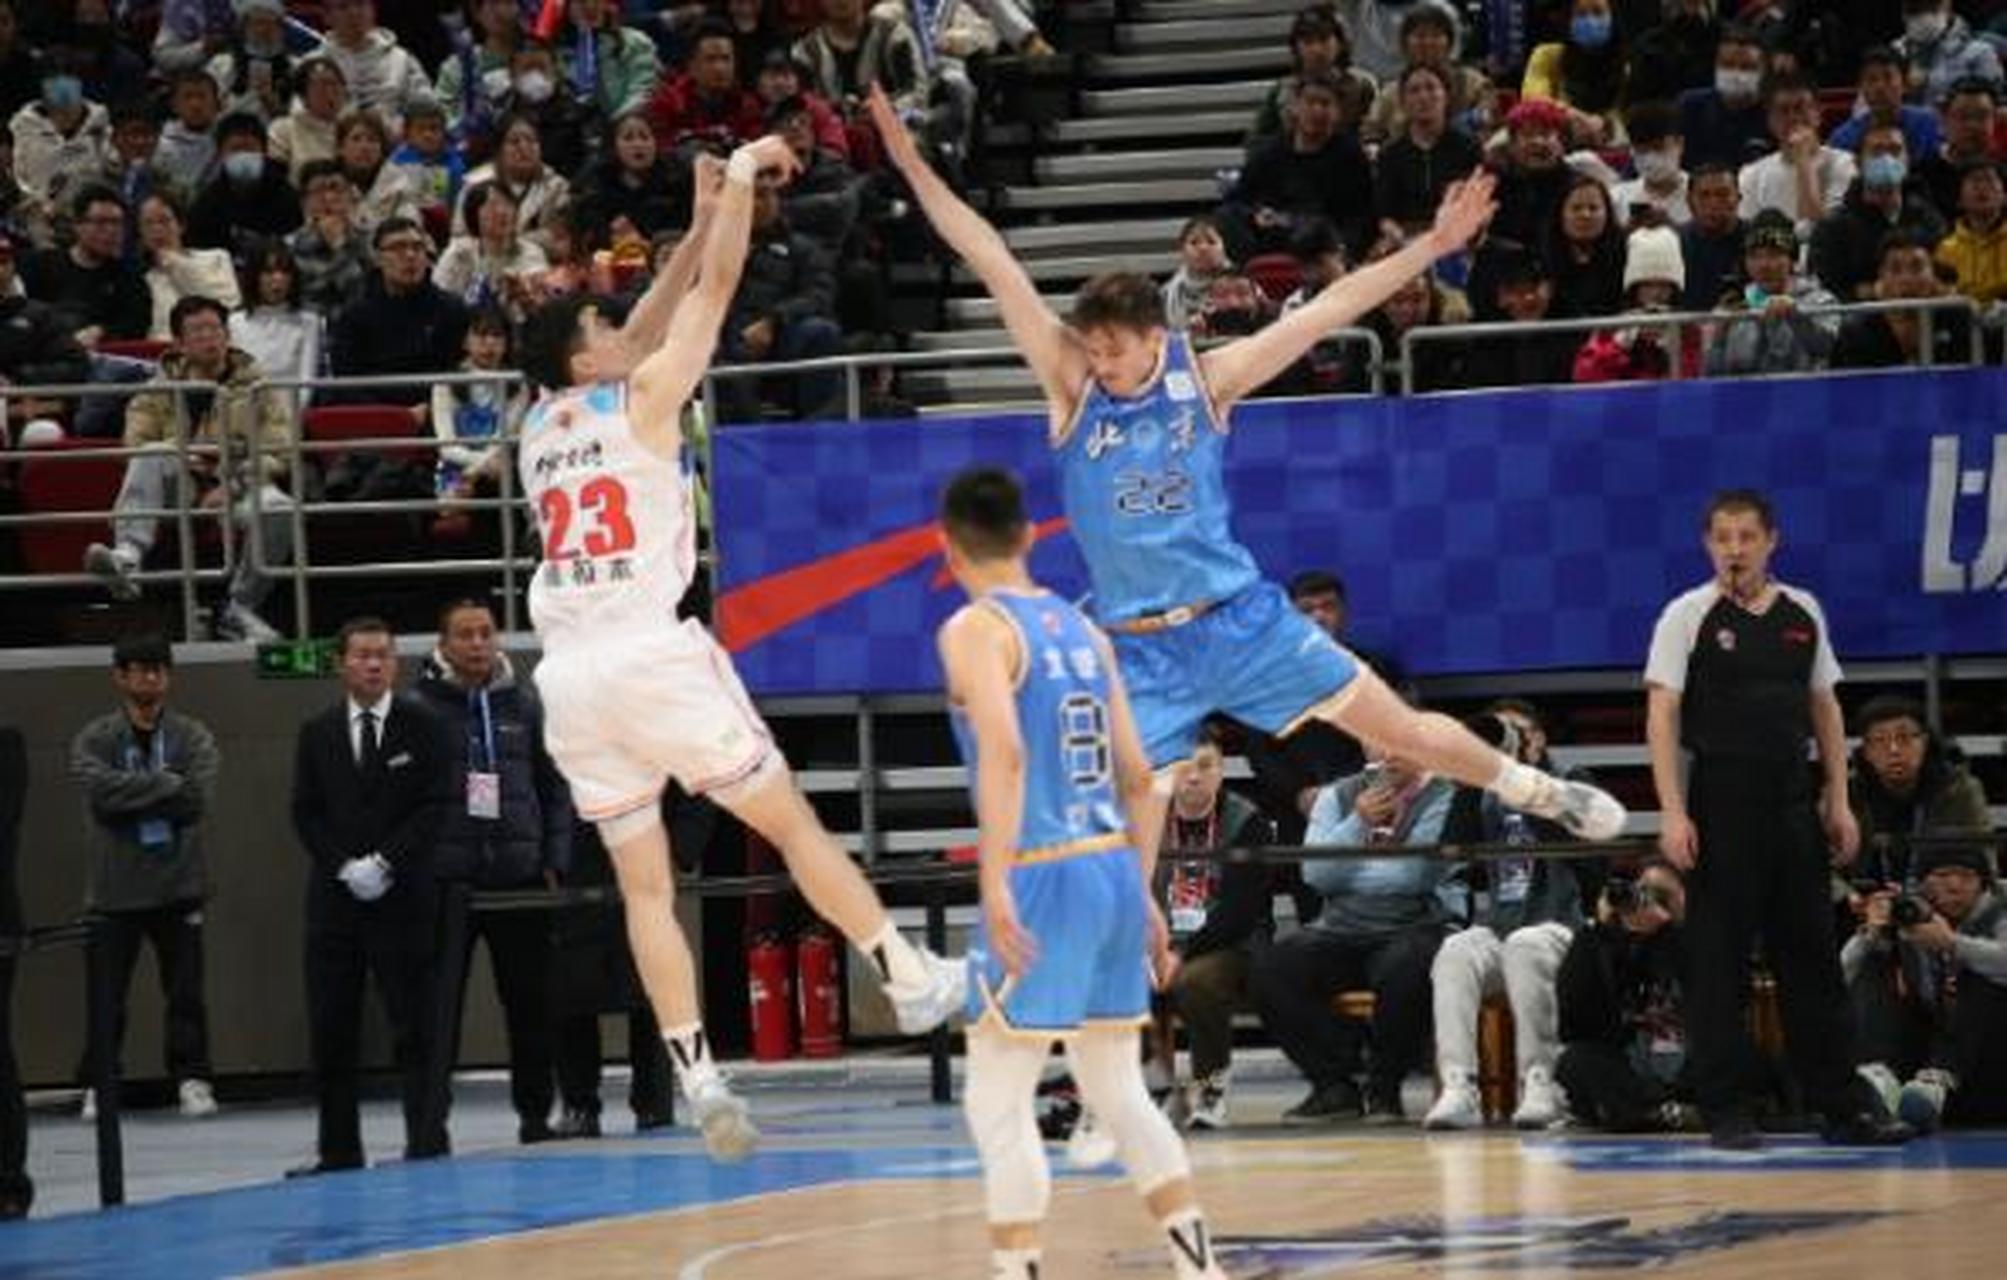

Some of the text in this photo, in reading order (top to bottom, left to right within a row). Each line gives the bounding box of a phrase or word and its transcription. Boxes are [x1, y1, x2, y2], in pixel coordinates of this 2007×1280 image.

[540, 474, 637, 562] 23
[1113, 467, 1196, 518] 22
[1058, 691, 1114, 789] 8
